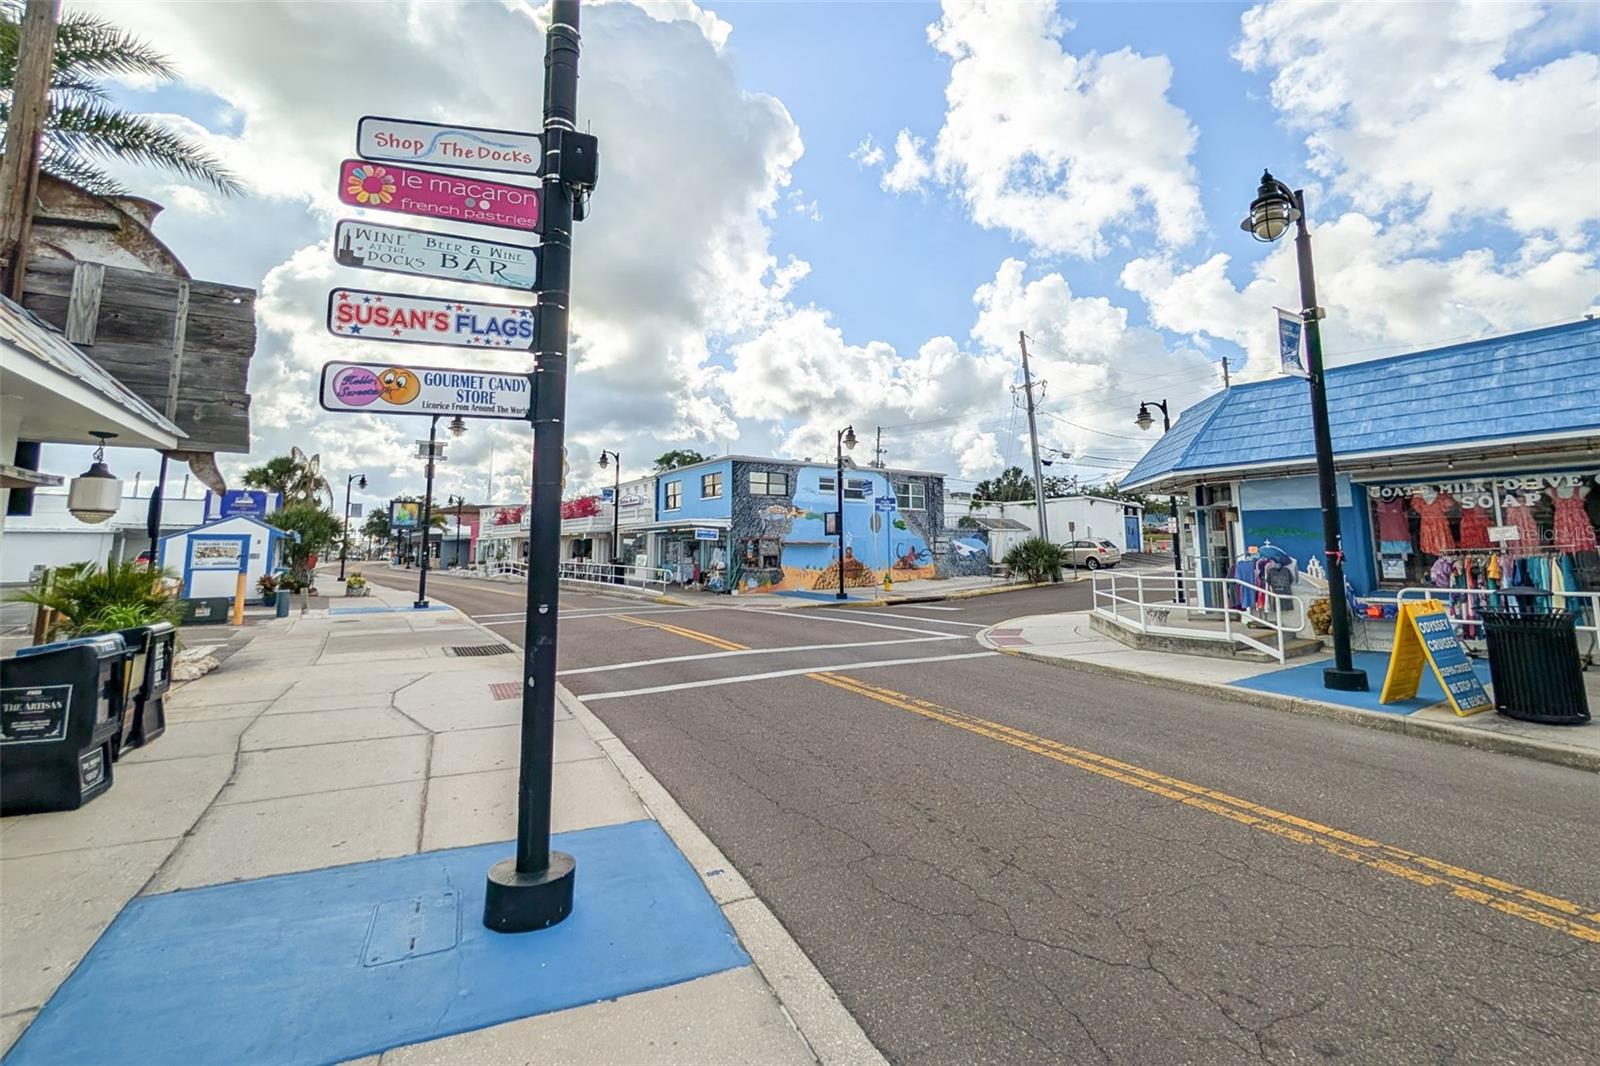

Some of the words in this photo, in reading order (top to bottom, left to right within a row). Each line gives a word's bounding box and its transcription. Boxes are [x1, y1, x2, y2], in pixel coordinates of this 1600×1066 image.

[374, 132, 424, 156] Shop
[439, 141, 474, 160] The
[401, 171, 423, 189] le
[429, 178, 538, 209] macaron
[401, 197, 460, 216] french
[464, 208, 537, 227] pastries
[355, 227, 407, 247] WINE
[470, 245, 480, 255] &
[368, 250, 426, 272] DOCKS
[440, 252, 523, 286] BAR
[336, 305, 449, 332] SUSAN'S
[455, 313, 533, 339] FLAGS
[424, 372, 484, 390] GOURMET
[488, 377, 528, 392] CANDY
[456, 389, 496, 405] STORE
[422, 401, 451, 411] Licorice
[452, 403, 469, 411] From
[471, 404, 496, 413] Around
[497, 405, 509, 413] The
[1440, 482, 1487, 494] MILK
[1461, 493, 1542, 510] SOAP
[1418, 618, 1449, 634] ODYSSEY
[1426, 636, 1458, 652] CRUISES
[3, 703, 23, 712] THE
[25, 701, 63, 710] ARTISAN
